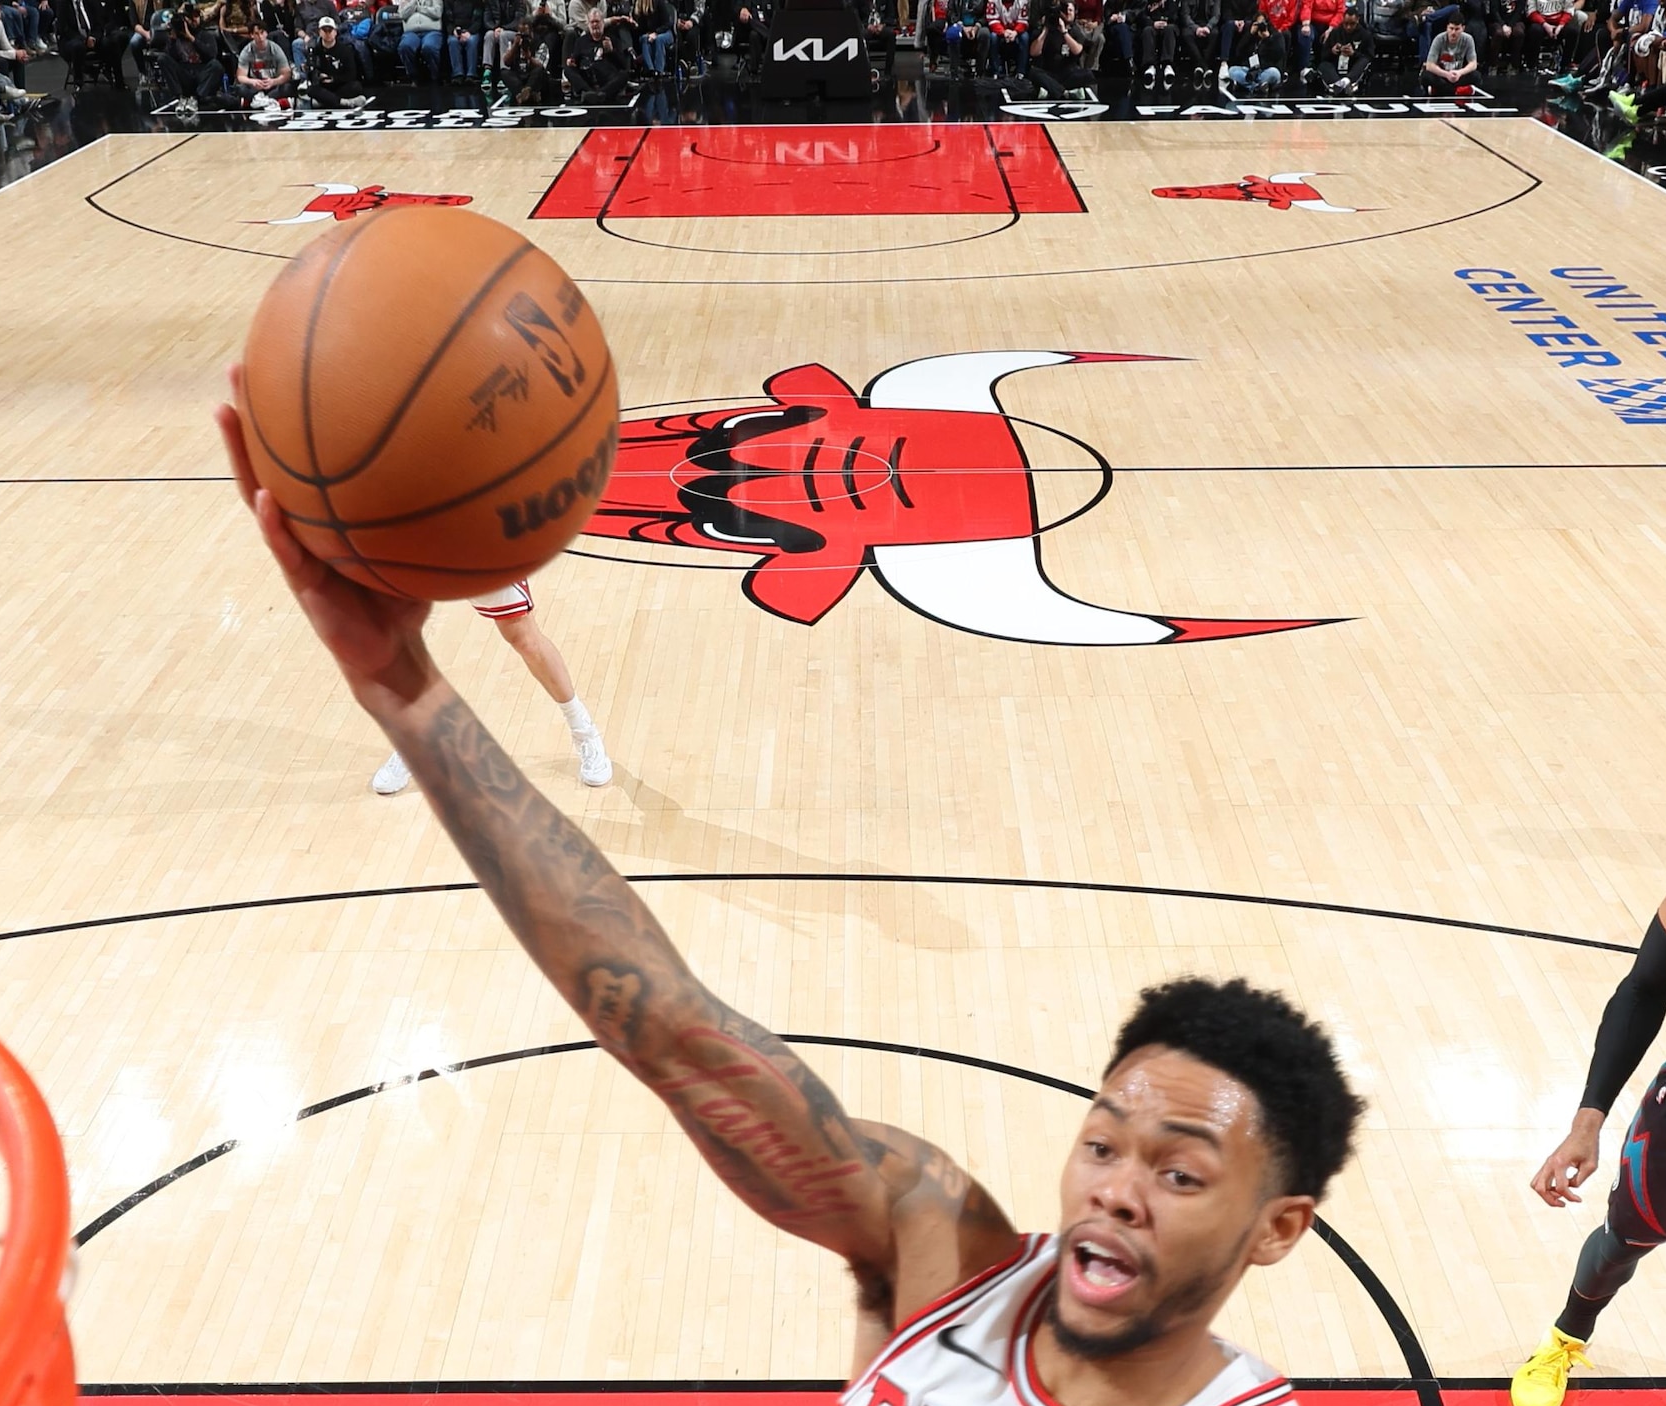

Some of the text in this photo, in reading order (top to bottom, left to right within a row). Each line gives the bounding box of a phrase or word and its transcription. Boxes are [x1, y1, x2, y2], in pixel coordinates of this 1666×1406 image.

[773, 38, 858, 61] KIA
[248, 108, 588, 122] CHICAGO
[1135, 103, 1519, 116] FANDUEL
[278, 117, 523, 130] BULLS
[1453, 267, 1623, 369] CENTER
